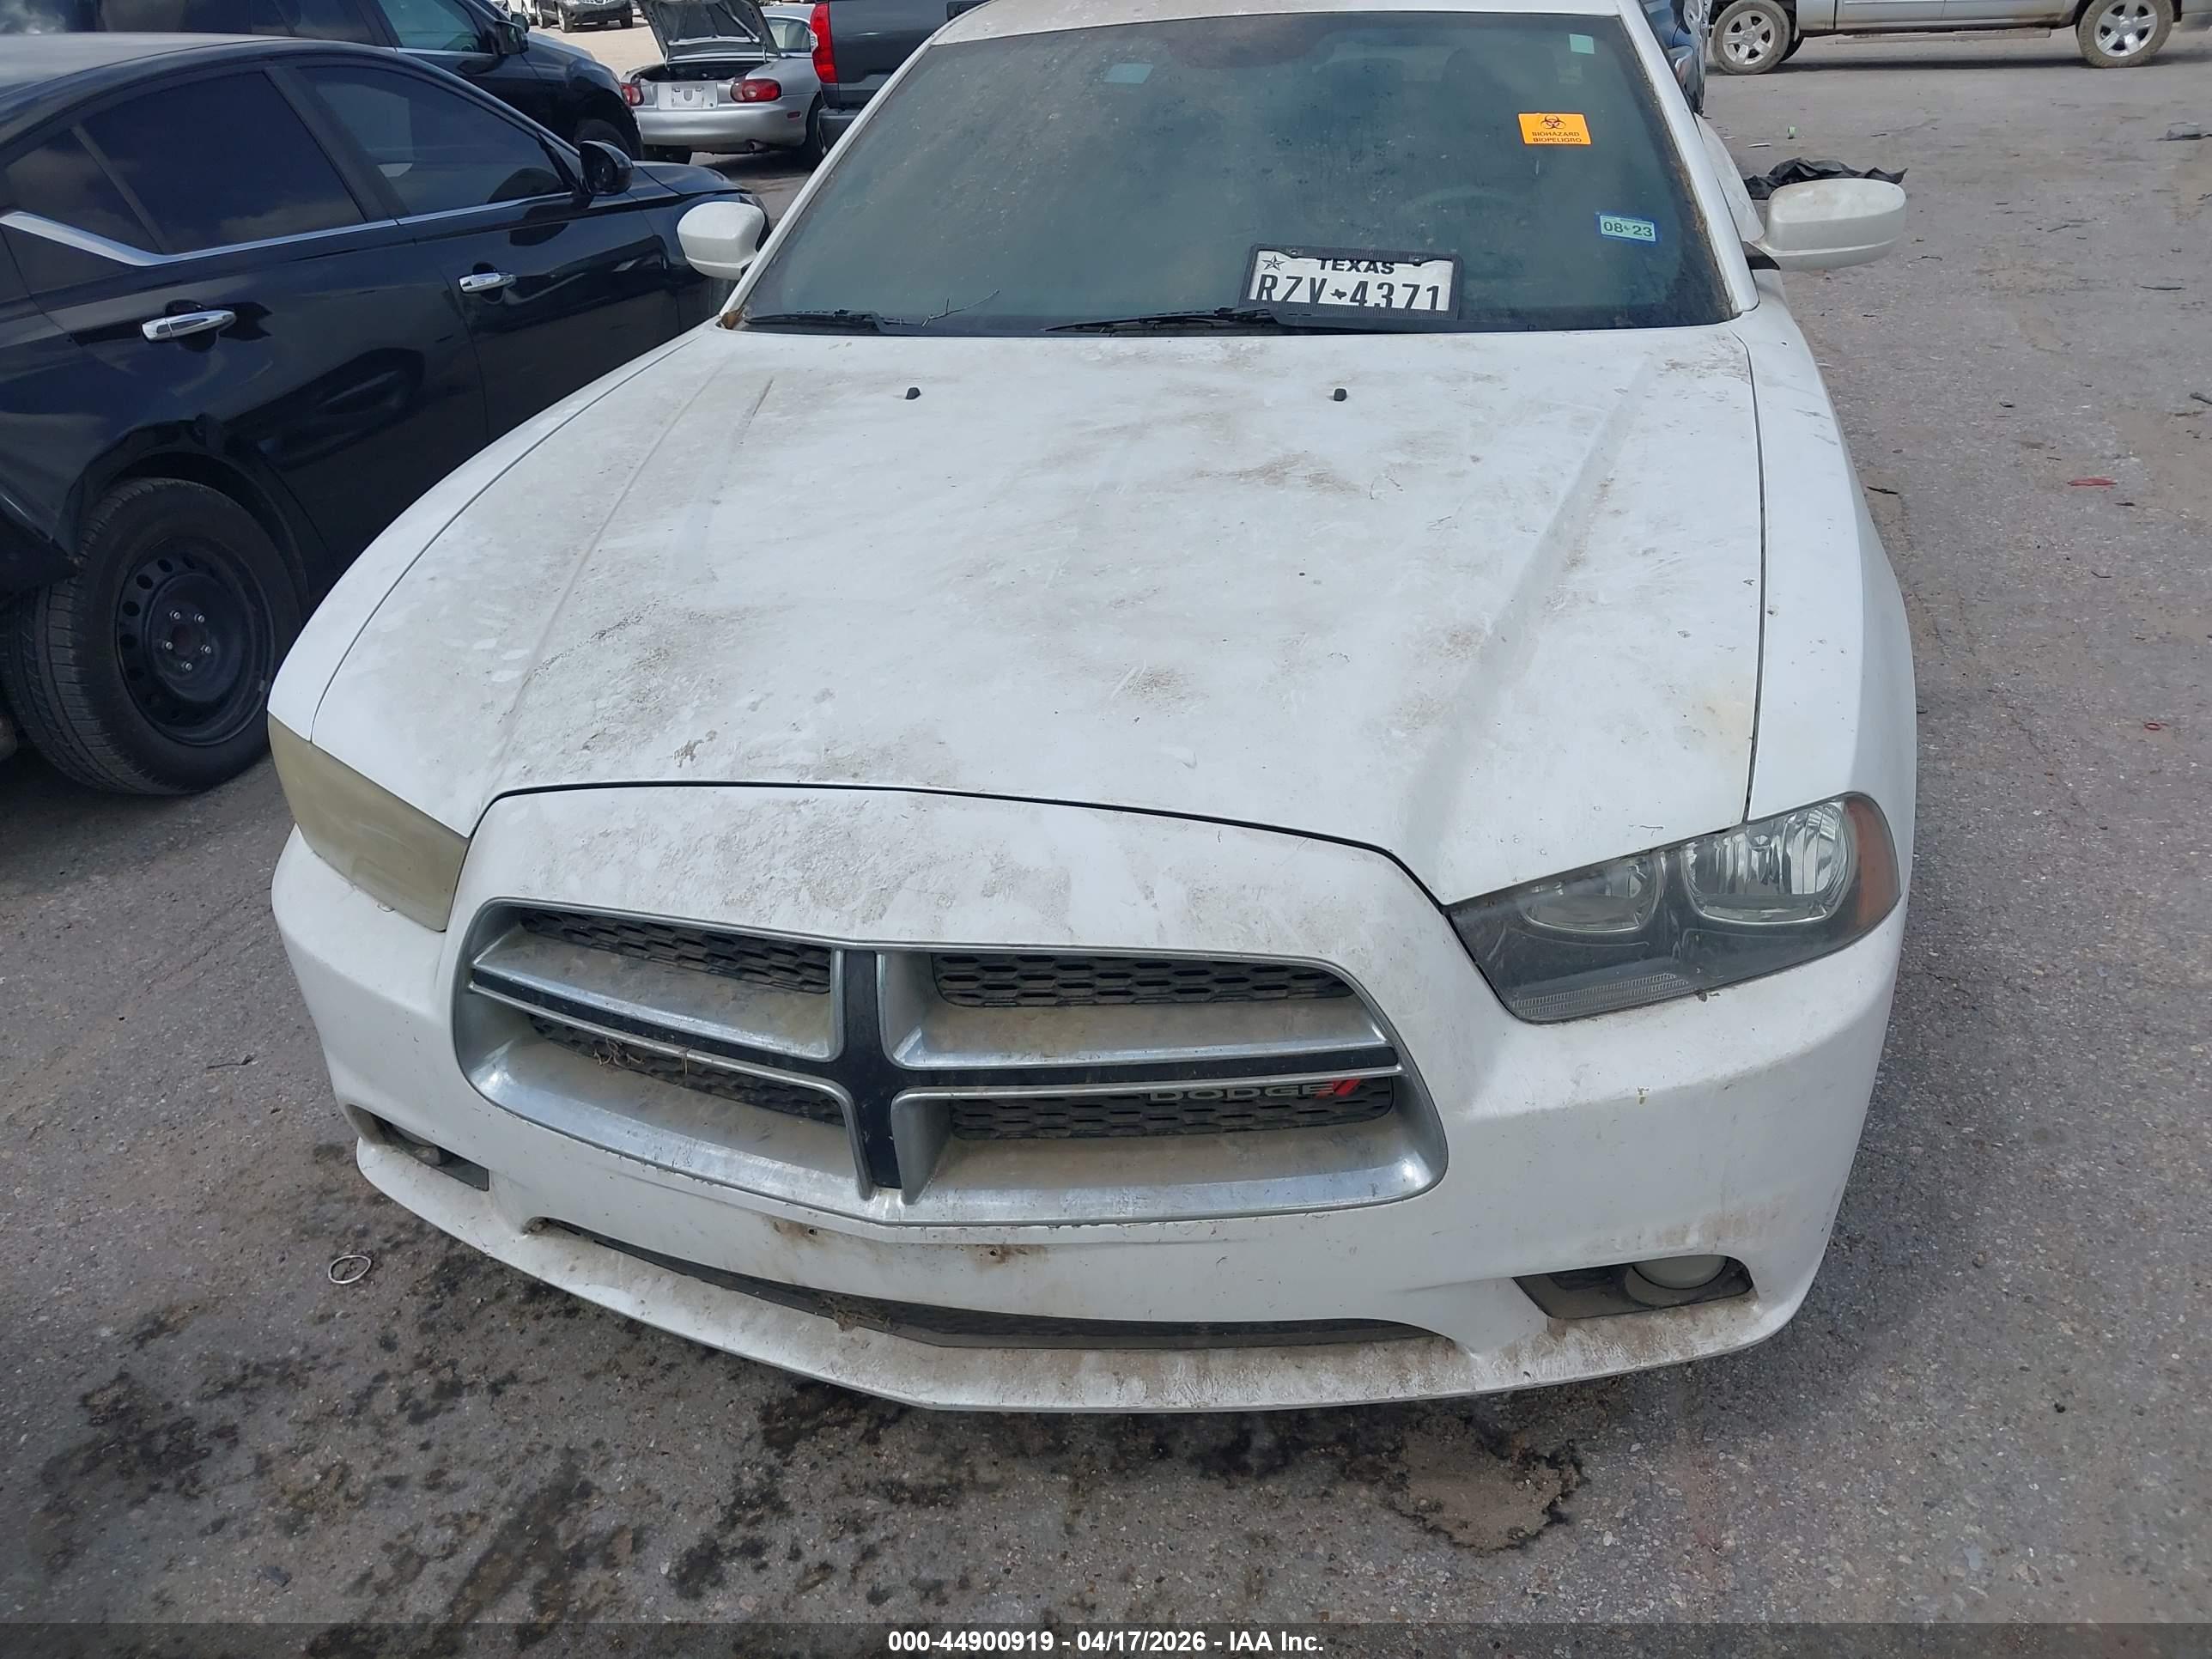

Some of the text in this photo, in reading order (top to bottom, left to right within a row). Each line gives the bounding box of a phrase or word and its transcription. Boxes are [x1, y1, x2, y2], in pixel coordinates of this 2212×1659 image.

[1603, 221, 1624, 234] 08
[1632, 225, 1653, 237] 23
[1316, 258, 1395, 275] TEXAS
[1349, 280, 1440, 311] 4371
[1150, 1083, 1334, 1101] DODGE
